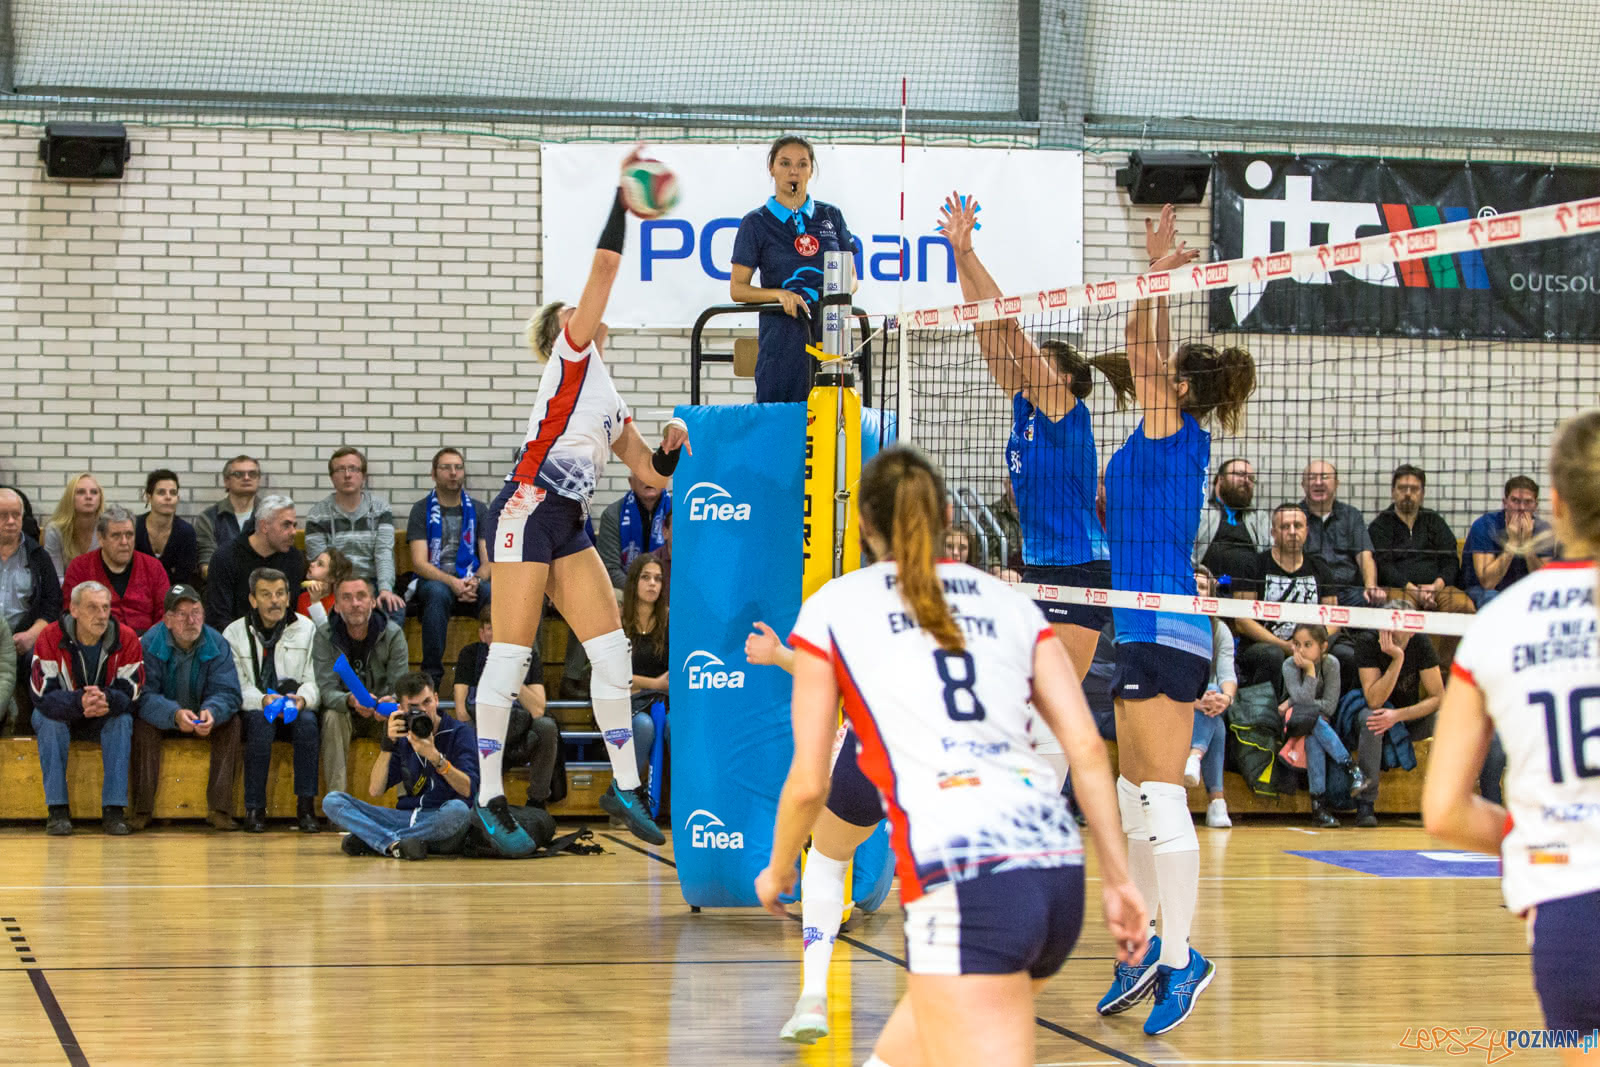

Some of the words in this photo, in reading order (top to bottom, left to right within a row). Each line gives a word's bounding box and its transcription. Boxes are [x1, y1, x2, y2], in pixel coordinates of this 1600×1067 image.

[690, 497, 751, 521] Enea
[504, 533, 514, 548] 3
[688, 665, 745, 690] Enea
[933, 648, 985, 722] 8
[1528, 686, 1600, 783] 16
[692, 824, 744, 850] Enea
